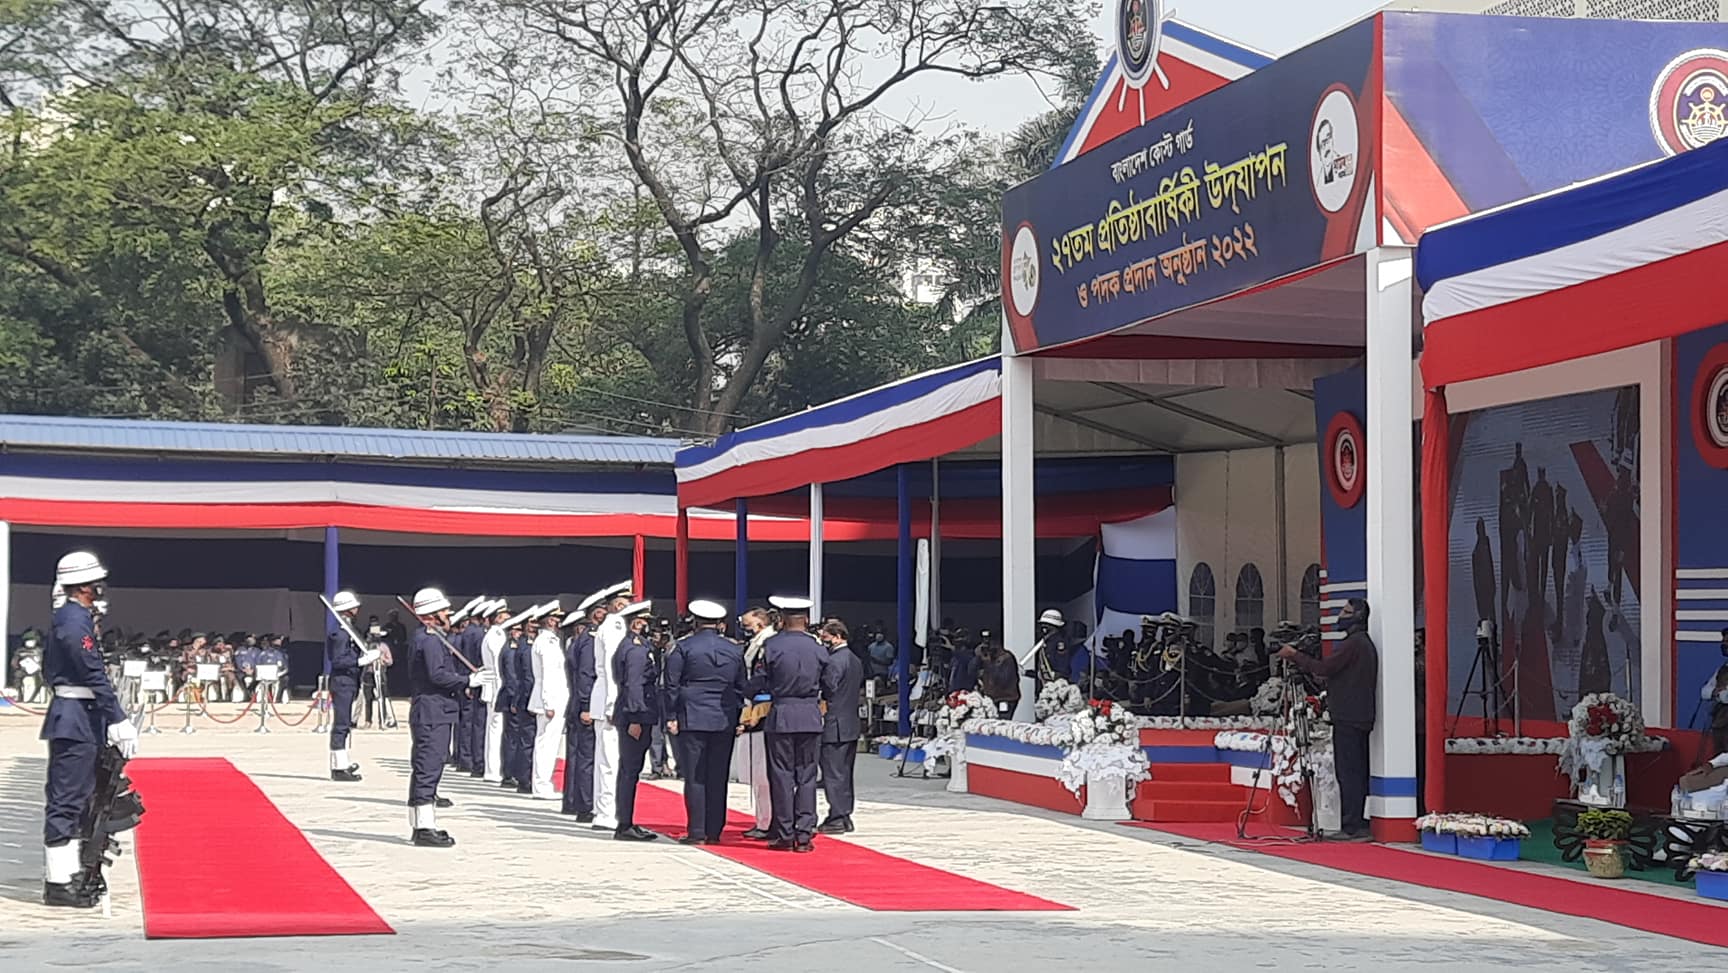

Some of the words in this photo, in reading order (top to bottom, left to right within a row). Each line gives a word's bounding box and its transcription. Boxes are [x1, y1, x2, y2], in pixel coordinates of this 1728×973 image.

[1110, 149, 1148, 184] বাংলাদেশ
[1149, 134, 1174, 168] কোস্ট
[1175, 119, 1194, 154] গার্ড
[1051, 222, 1095, 275] ২৭তম
[1097, 166, 1201, 255] প্রতিষ্ঠাবার্ষিকী
[1076, 282, 1089, 308] ও
[1090, 272, 1121, 305] পদক
[1123, 258, 1157, 296] প্রদান
[1158, 232, 1208, 285] অনুষ্ঠান
[1211, 222, 1259, 269] ২০২২
